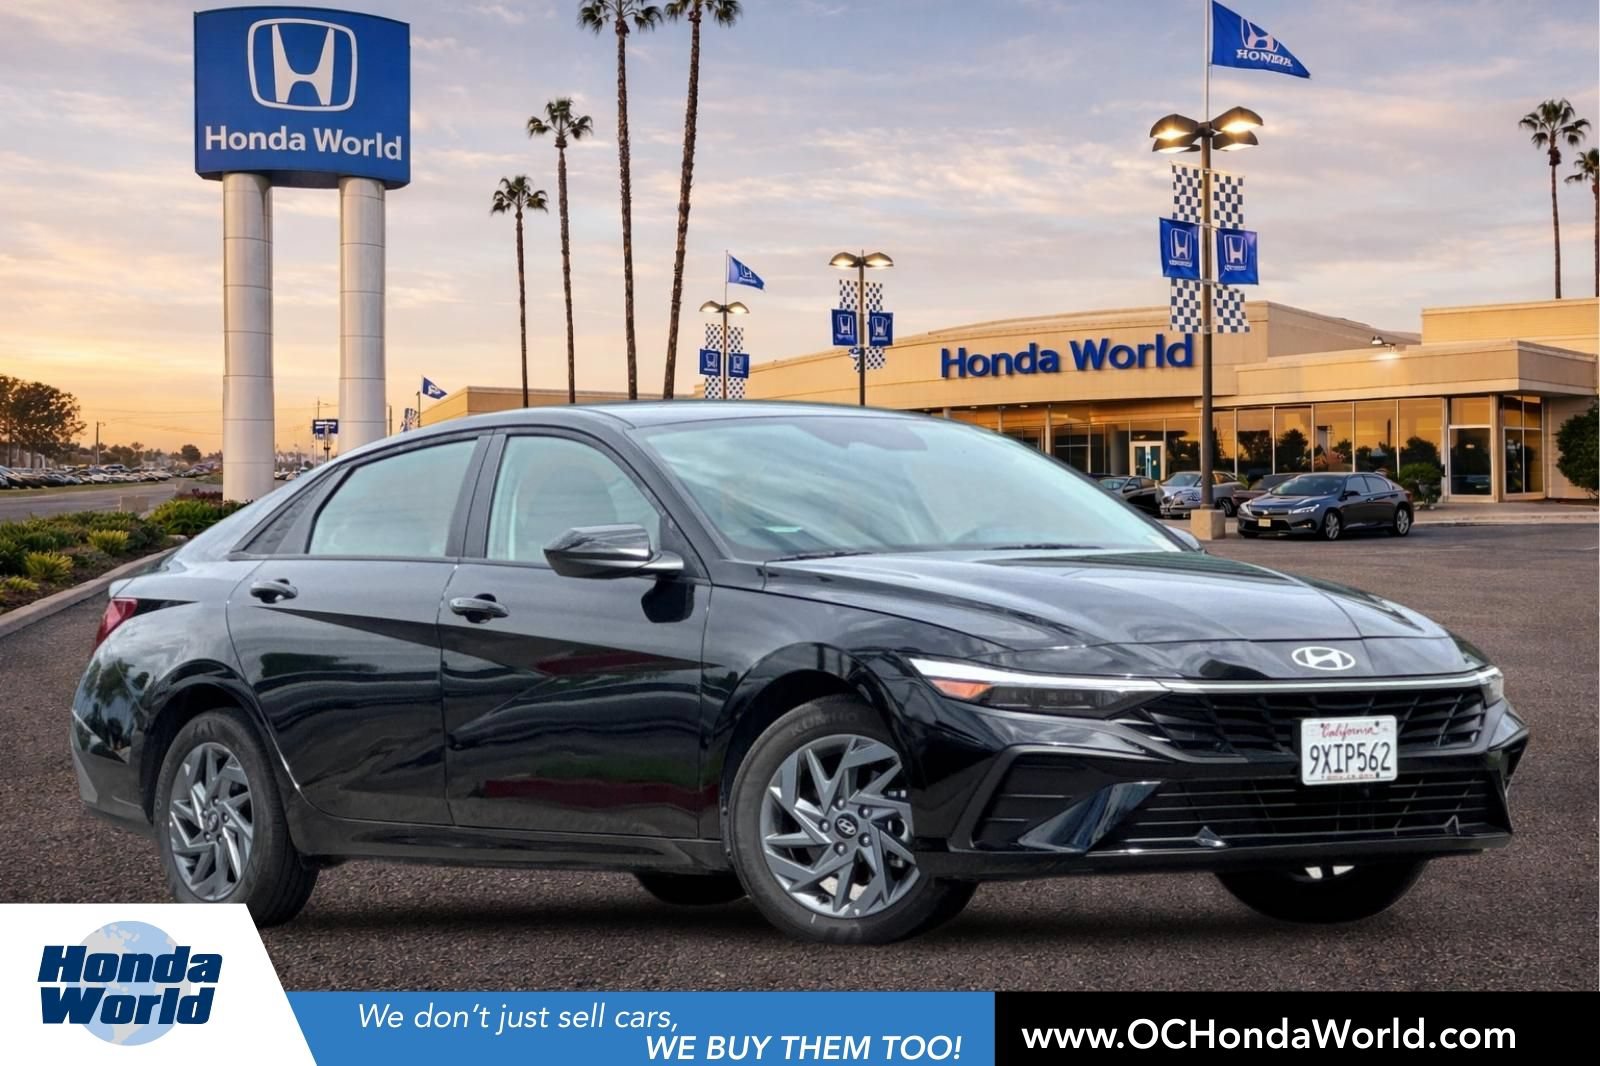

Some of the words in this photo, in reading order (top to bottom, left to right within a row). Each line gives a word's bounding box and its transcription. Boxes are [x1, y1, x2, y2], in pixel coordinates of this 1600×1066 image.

[205, 125, 306, 151] Honda
[313, 127, 402, 160] World
[941, 342, 1061, 378] Honda
[1069, 333, 1195, 370] World
[1321, 723, 1378, 741] California
[1309, 742, 1391, 775] 9XIP562
